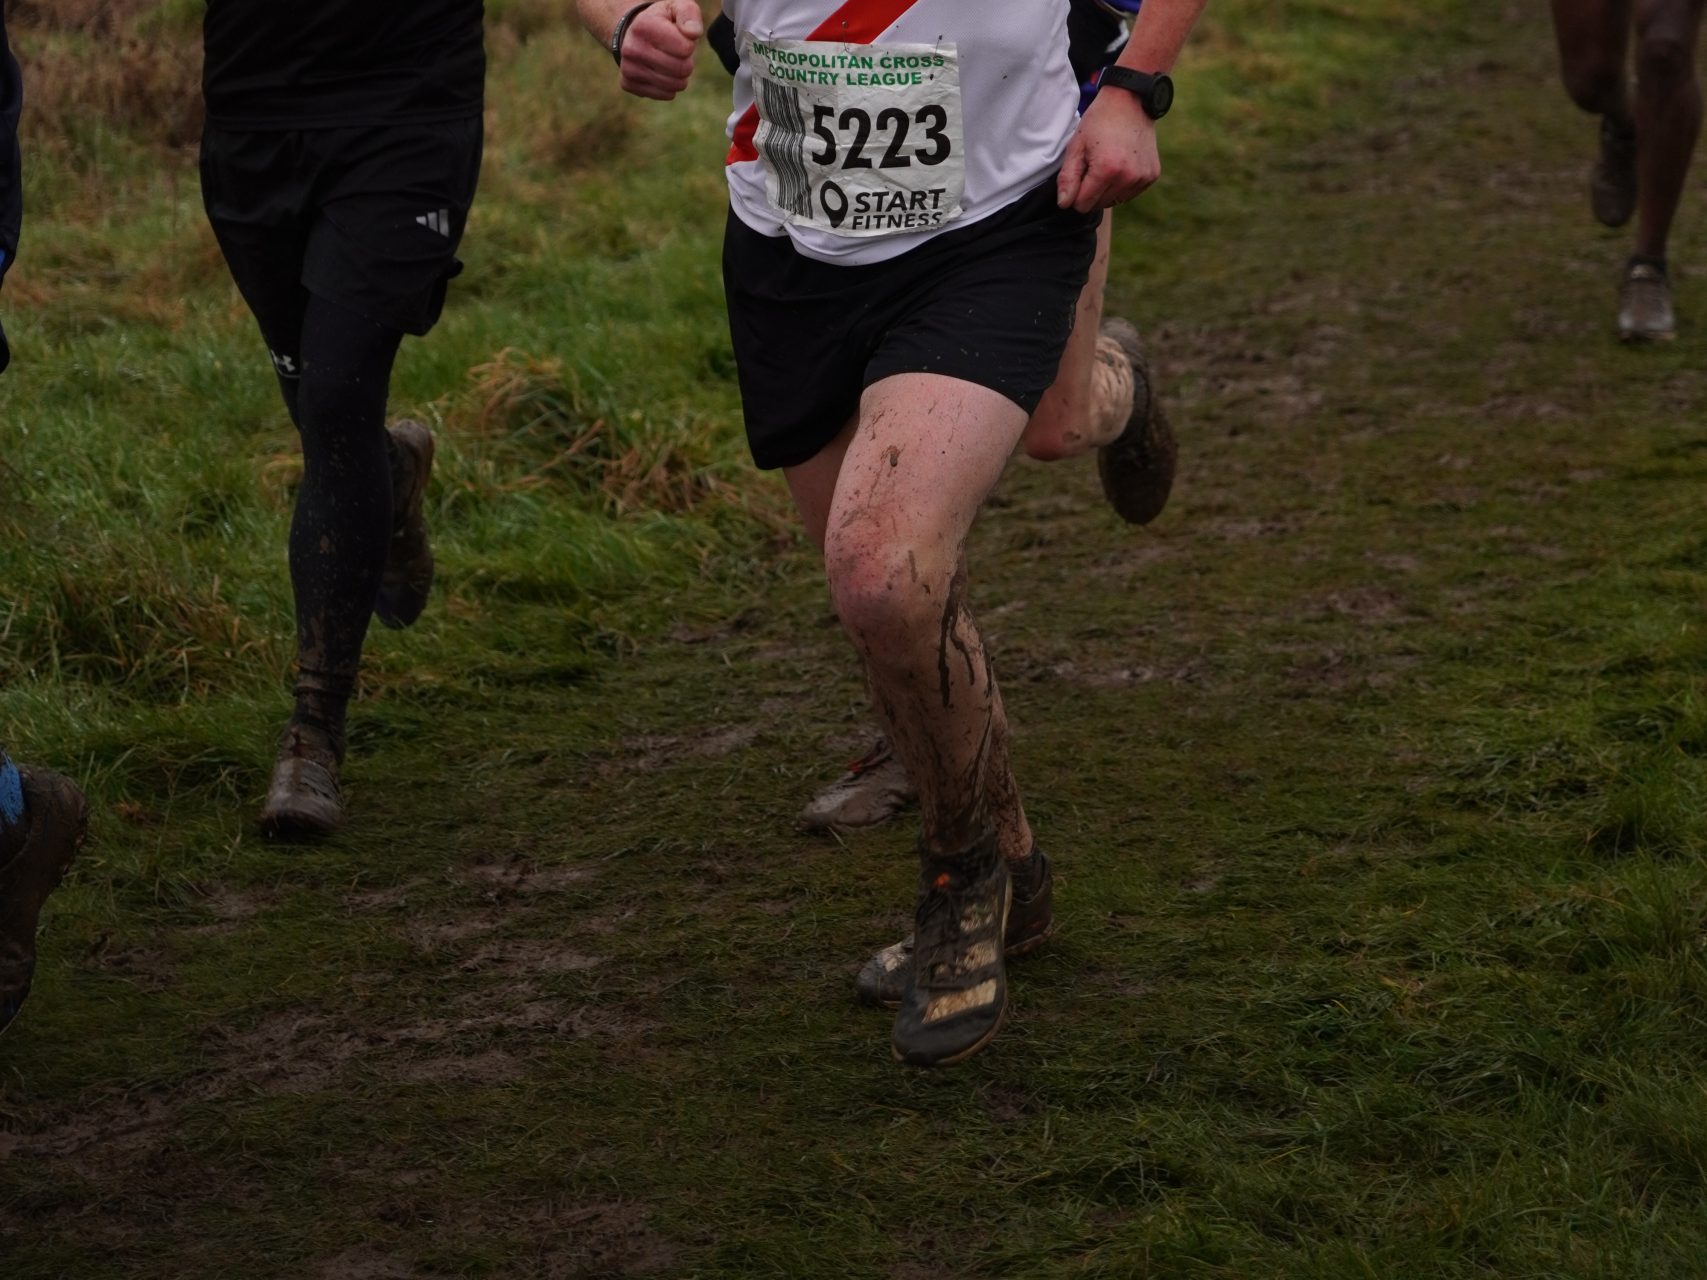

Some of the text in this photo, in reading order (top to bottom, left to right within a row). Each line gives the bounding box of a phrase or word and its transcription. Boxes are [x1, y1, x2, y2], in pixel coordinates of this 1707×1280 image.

[753, 42, 945, 69] METROPOLITAN CROSS
[768, 63, 922, 86] COUNTRY LEAGUE
[812, 104, 951, 170] 5223
[854, 188, 946, 214] START
[852, 211, 944, 231] FITNESS
